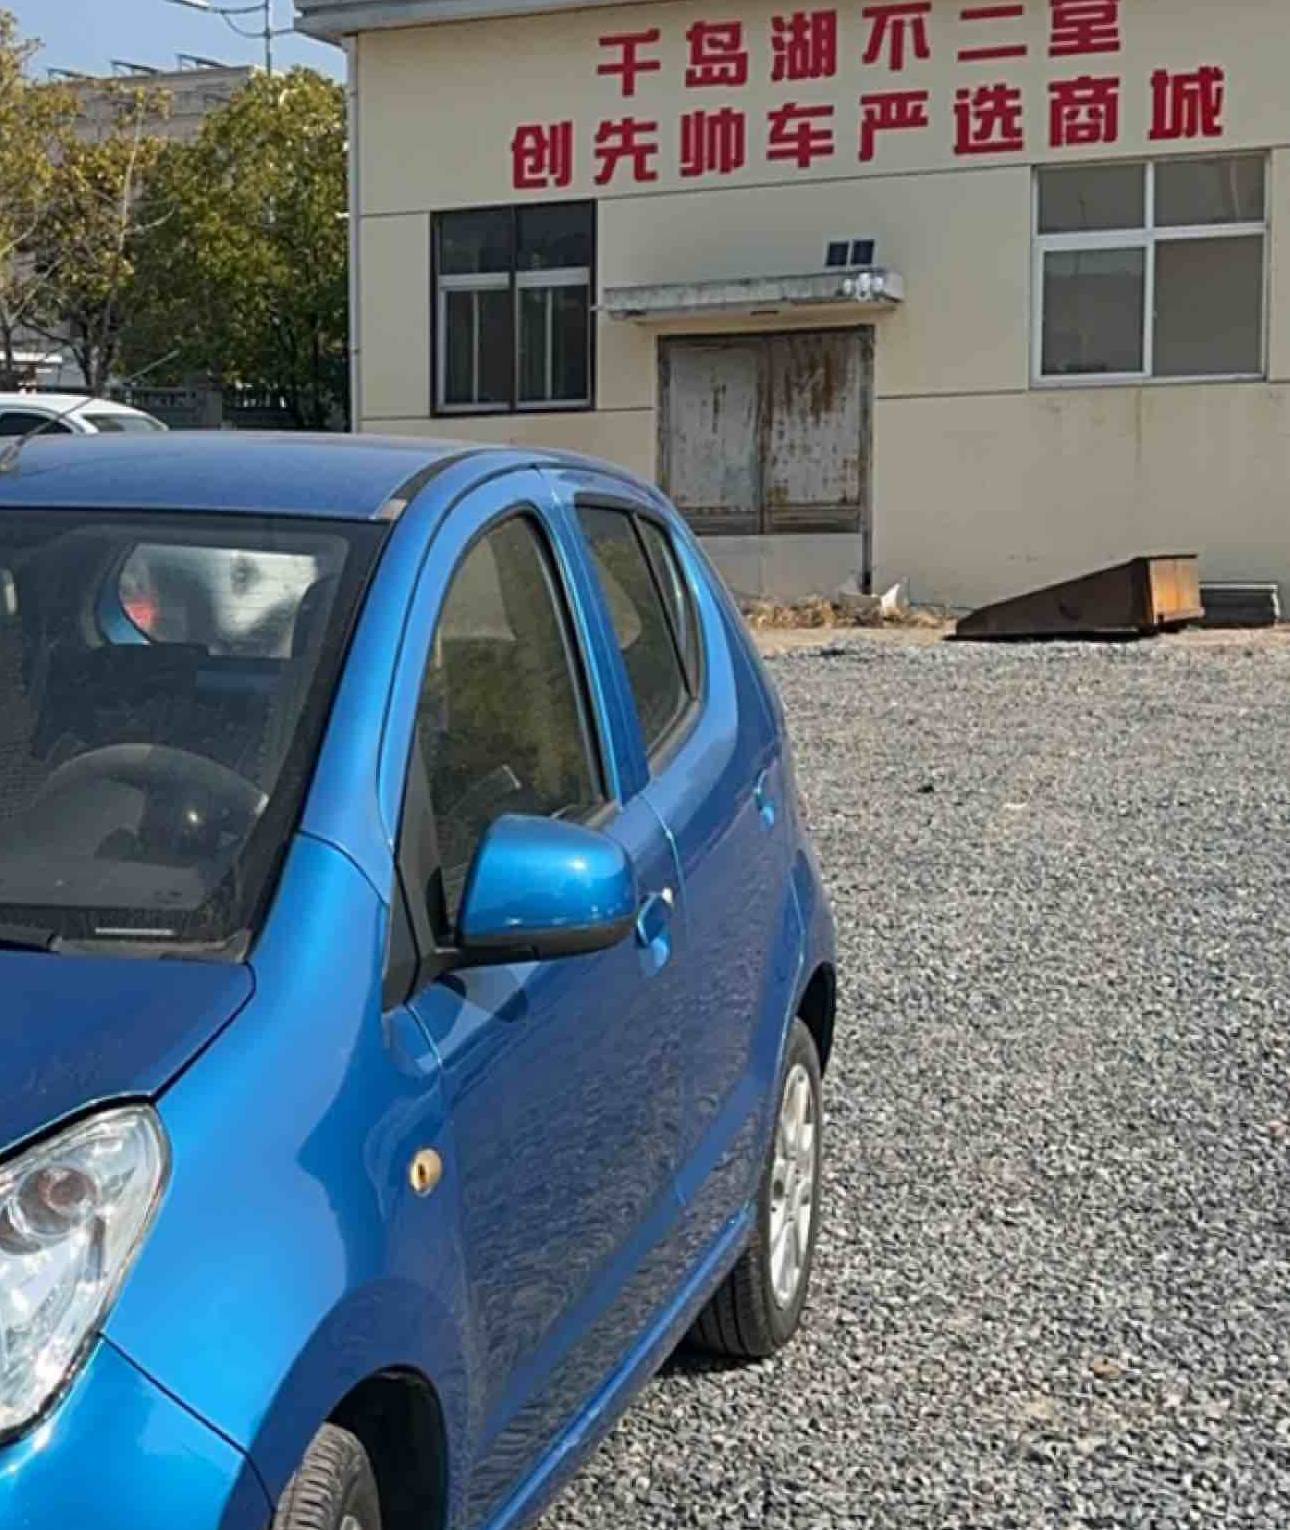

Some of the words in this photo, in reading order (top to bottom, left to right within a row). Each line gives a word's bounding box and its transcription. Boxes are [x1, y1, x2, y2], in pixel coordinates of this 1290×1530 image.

[511, 66, 1225, 190] 创先帅车严选商城
